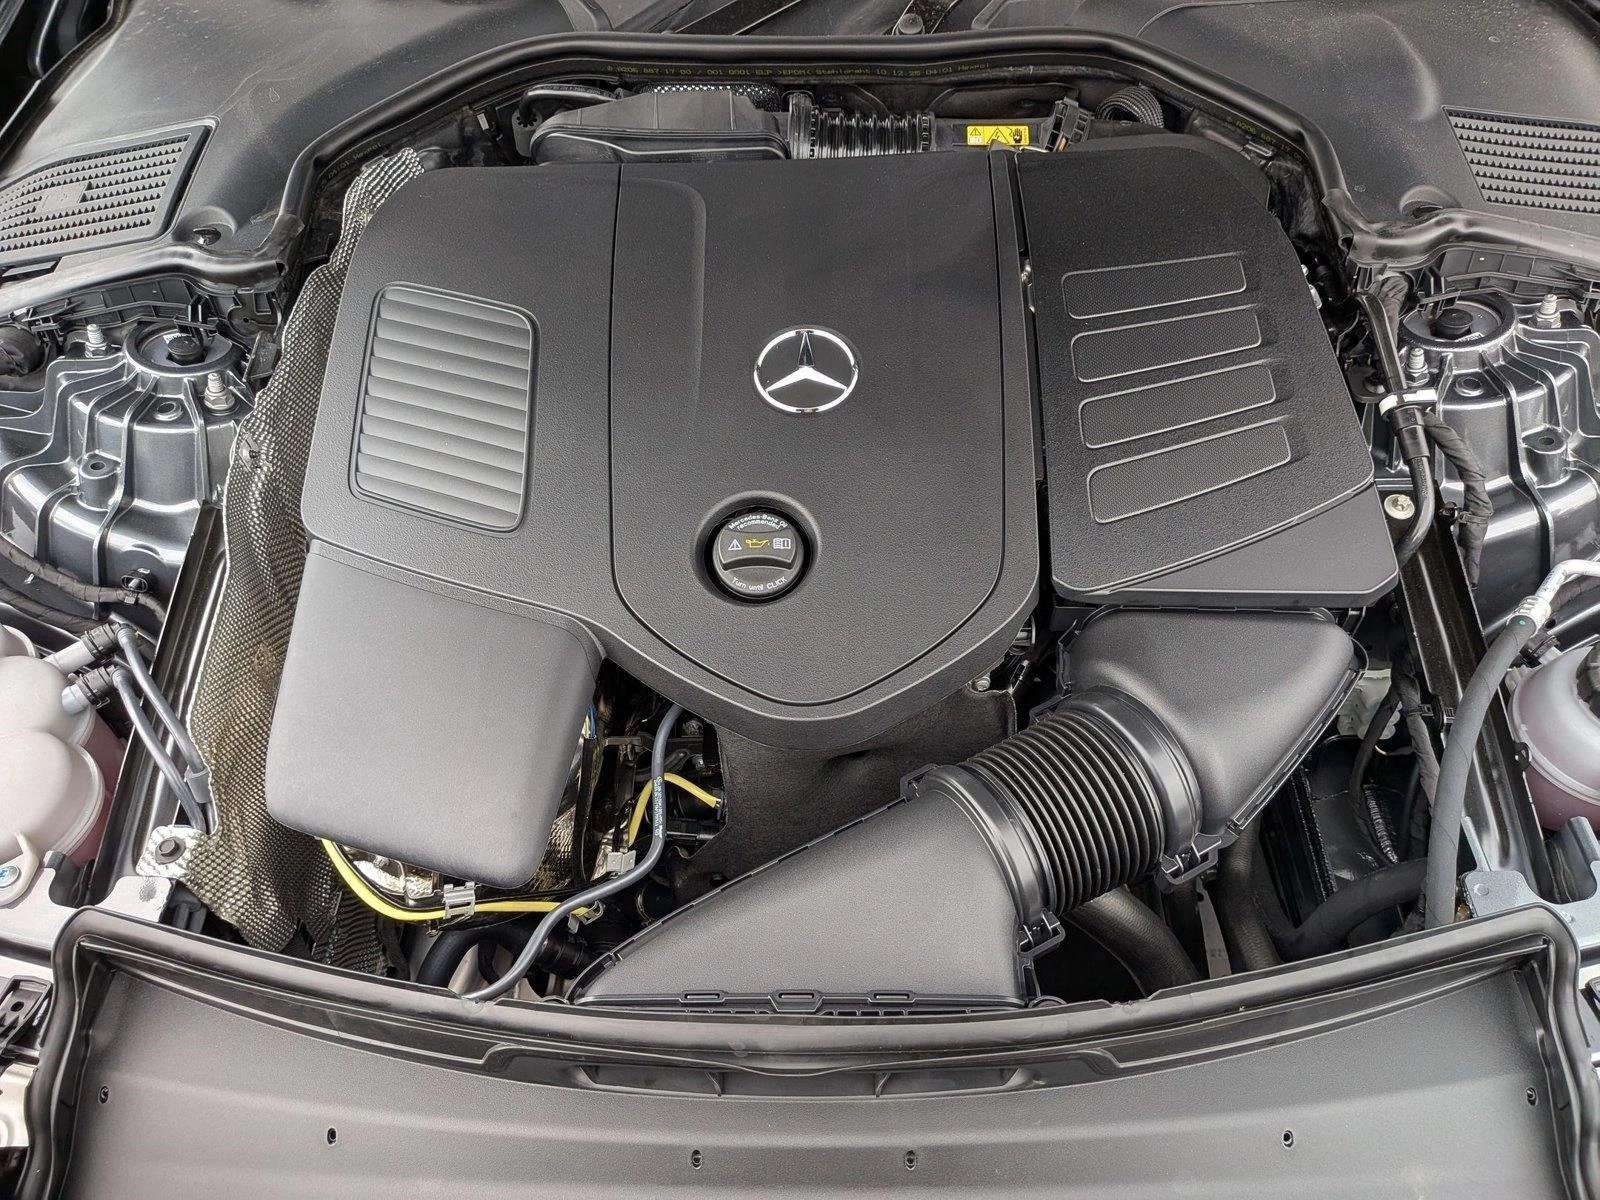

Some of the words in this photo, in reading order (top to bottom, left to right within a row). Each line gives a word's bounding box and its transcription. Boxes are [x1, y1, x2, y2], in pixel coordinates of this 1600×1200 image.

[728, 514, 778, 530] Mercedes-Benz
[736, 519, 781, 530] recommended
[731, 576, 747, 589] Turn
[748, 583, 764, 591] until
[766, 576, 788, 589] CLICK
